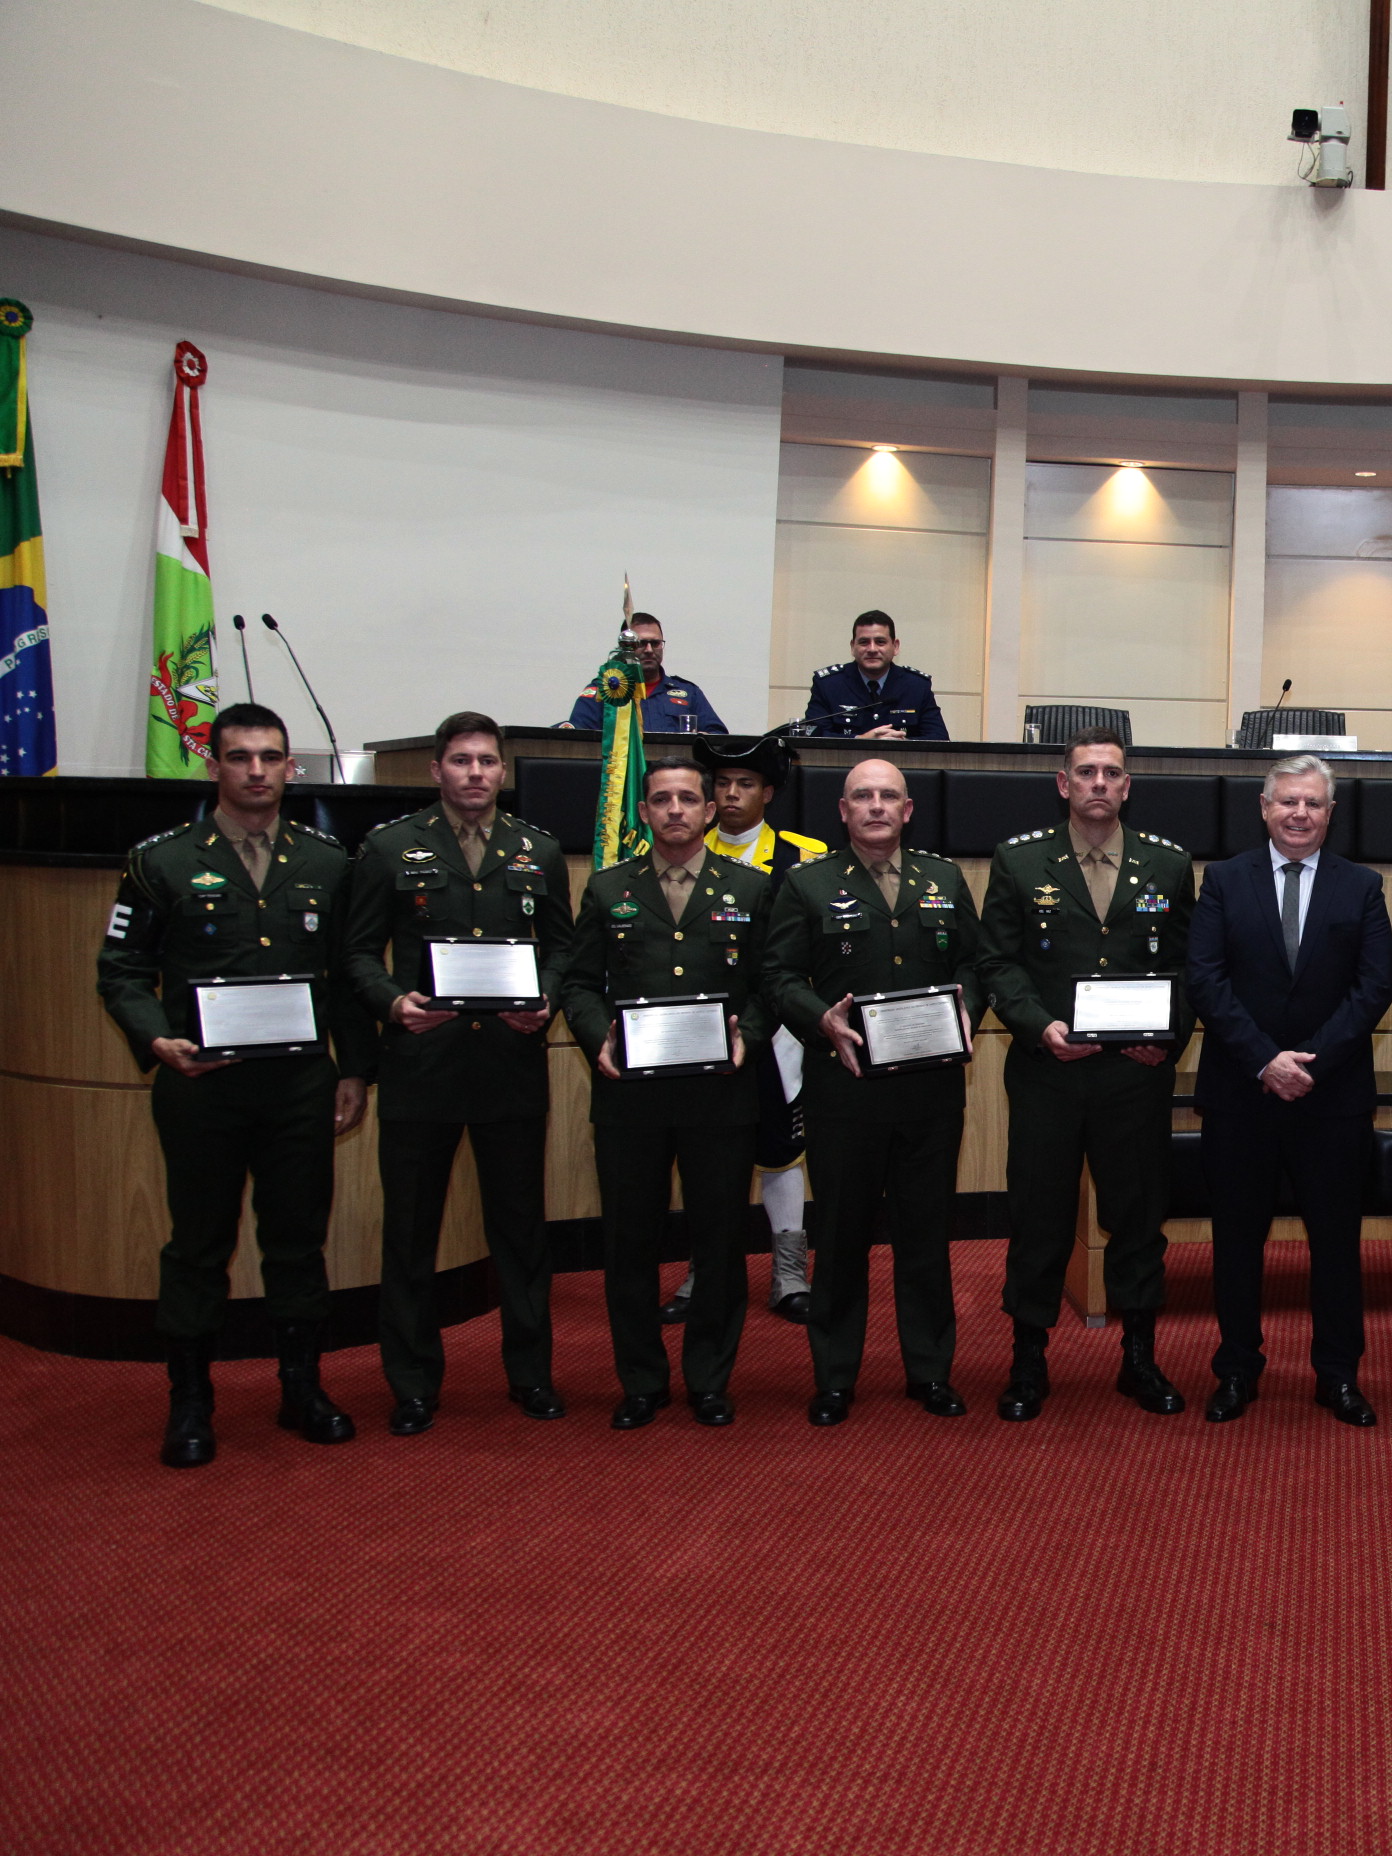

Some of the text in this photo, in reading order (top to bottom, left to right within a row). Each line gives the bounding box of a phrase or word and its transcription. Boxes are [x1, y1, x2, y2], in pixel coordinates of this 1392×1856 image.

[151, 676, 180, 721] ESTADO DE
[107, 903, 133, 939] E
